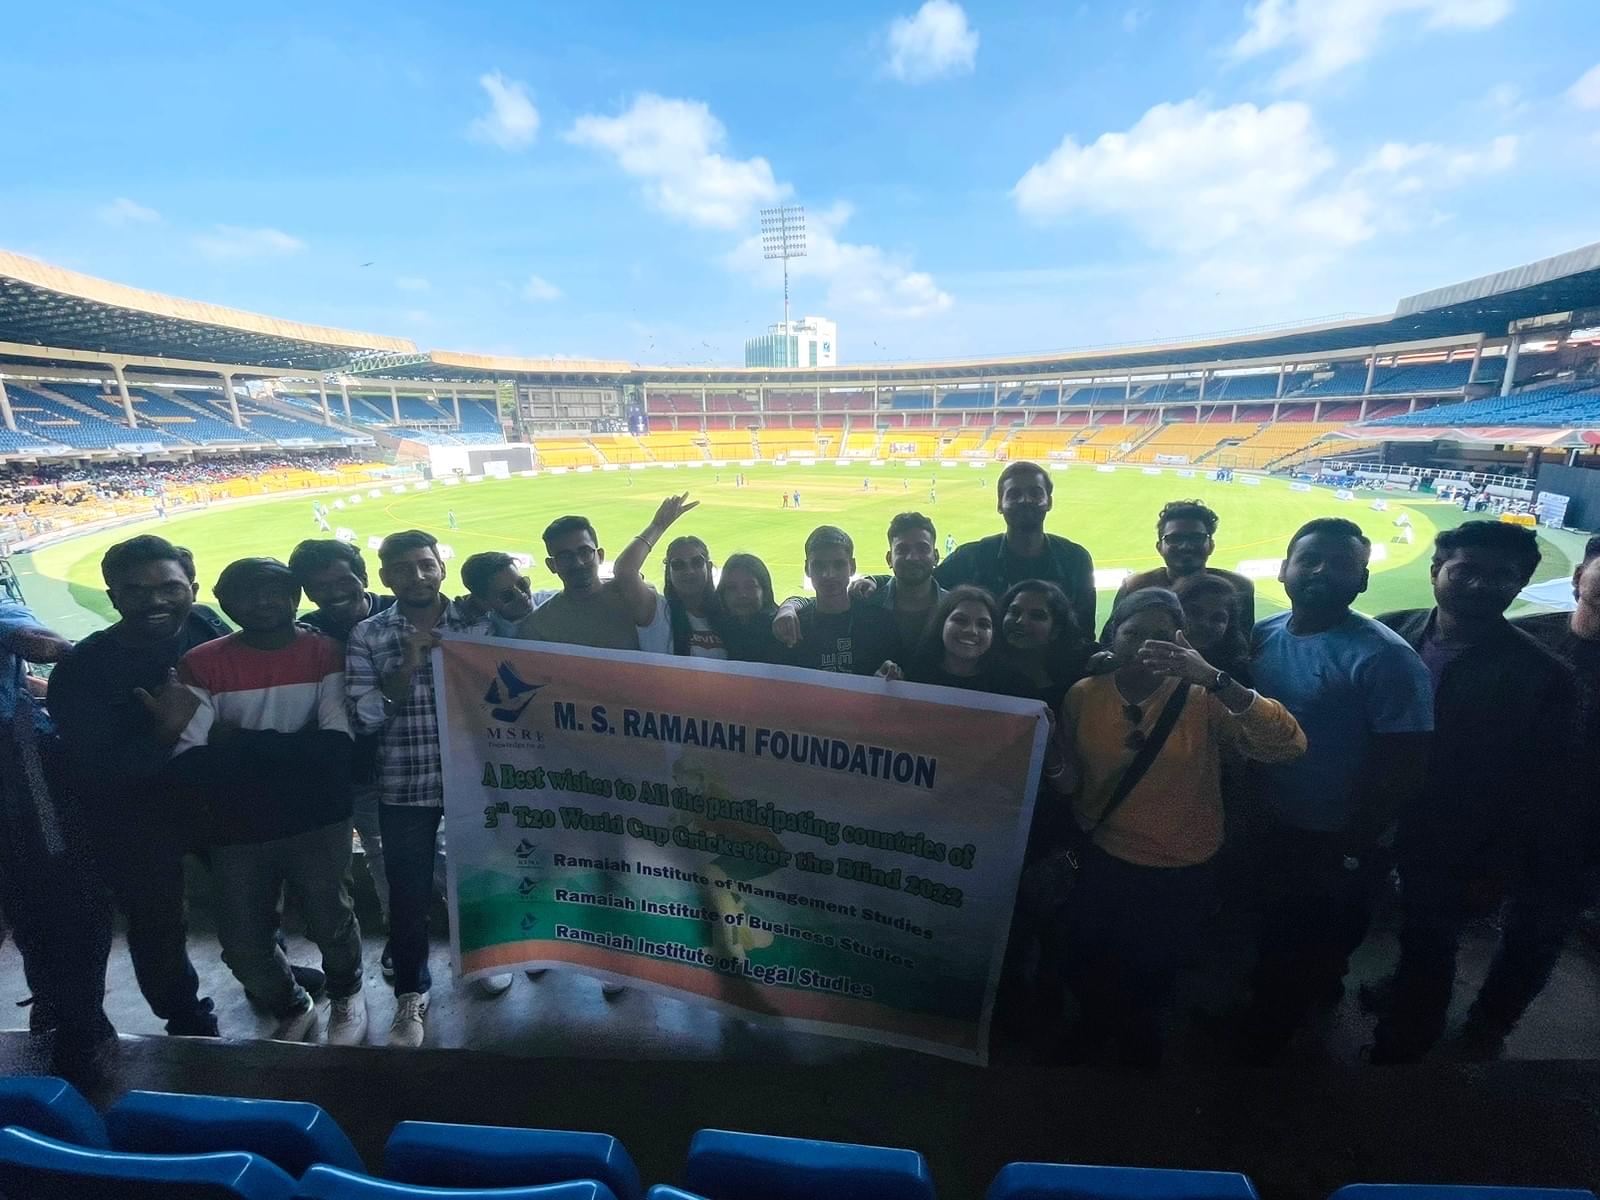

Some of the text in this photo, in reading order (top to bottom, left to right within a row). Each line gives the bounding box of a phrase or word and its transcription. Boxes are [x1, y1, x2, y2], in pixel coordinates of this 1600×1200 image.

[554, 701, 937, 789] M. S. RAMAIAH FOUNDATION
[482, 763, 977, 870] A Best wishes to All the participating countries of
[513, 807, 555, 828] T20
[560, 807, 624, 835] World
[627, 817, 669, 847] Cup
[673, 827, 754, 861] Cricket
[757, 841, 793, 867] for
[795, 852, 834, 876] the
[837, 857, 901, 890] Blind
[904, 875, 964, 908] 2022
[553, 853, 934, 940] Ramaiah Institute of Management Studies
[555, 888, 915, 969] Ramaiah Institute of Business Studies
[555, 925, 873, 997] Ramaiah Institute of Legal Studies
